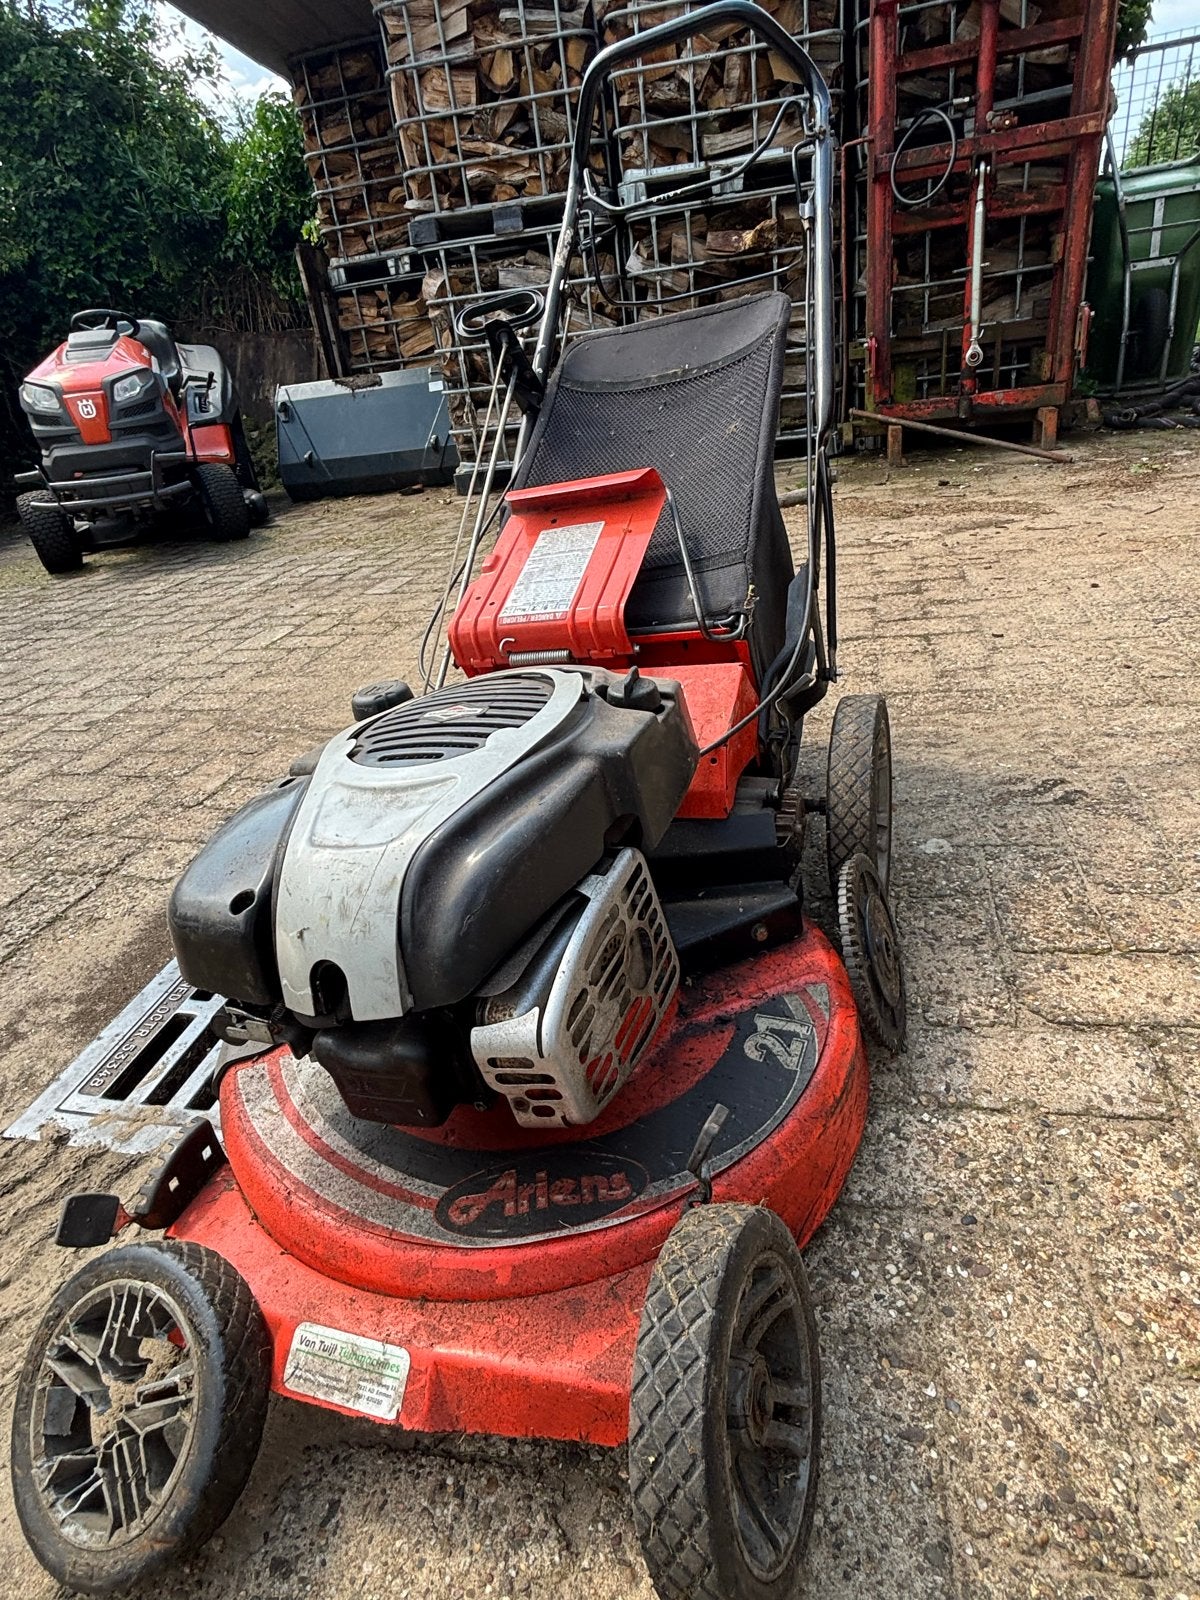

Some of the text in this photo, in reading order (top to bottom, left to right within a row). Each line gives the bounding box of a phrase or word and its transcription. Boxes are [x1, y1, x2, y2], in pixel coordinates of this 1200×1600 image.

[447, 1169, 633, 1226] Ariens
[299, 1334, 317, 1350] Van
[318, 1340, 338, 1357] Tuijl
